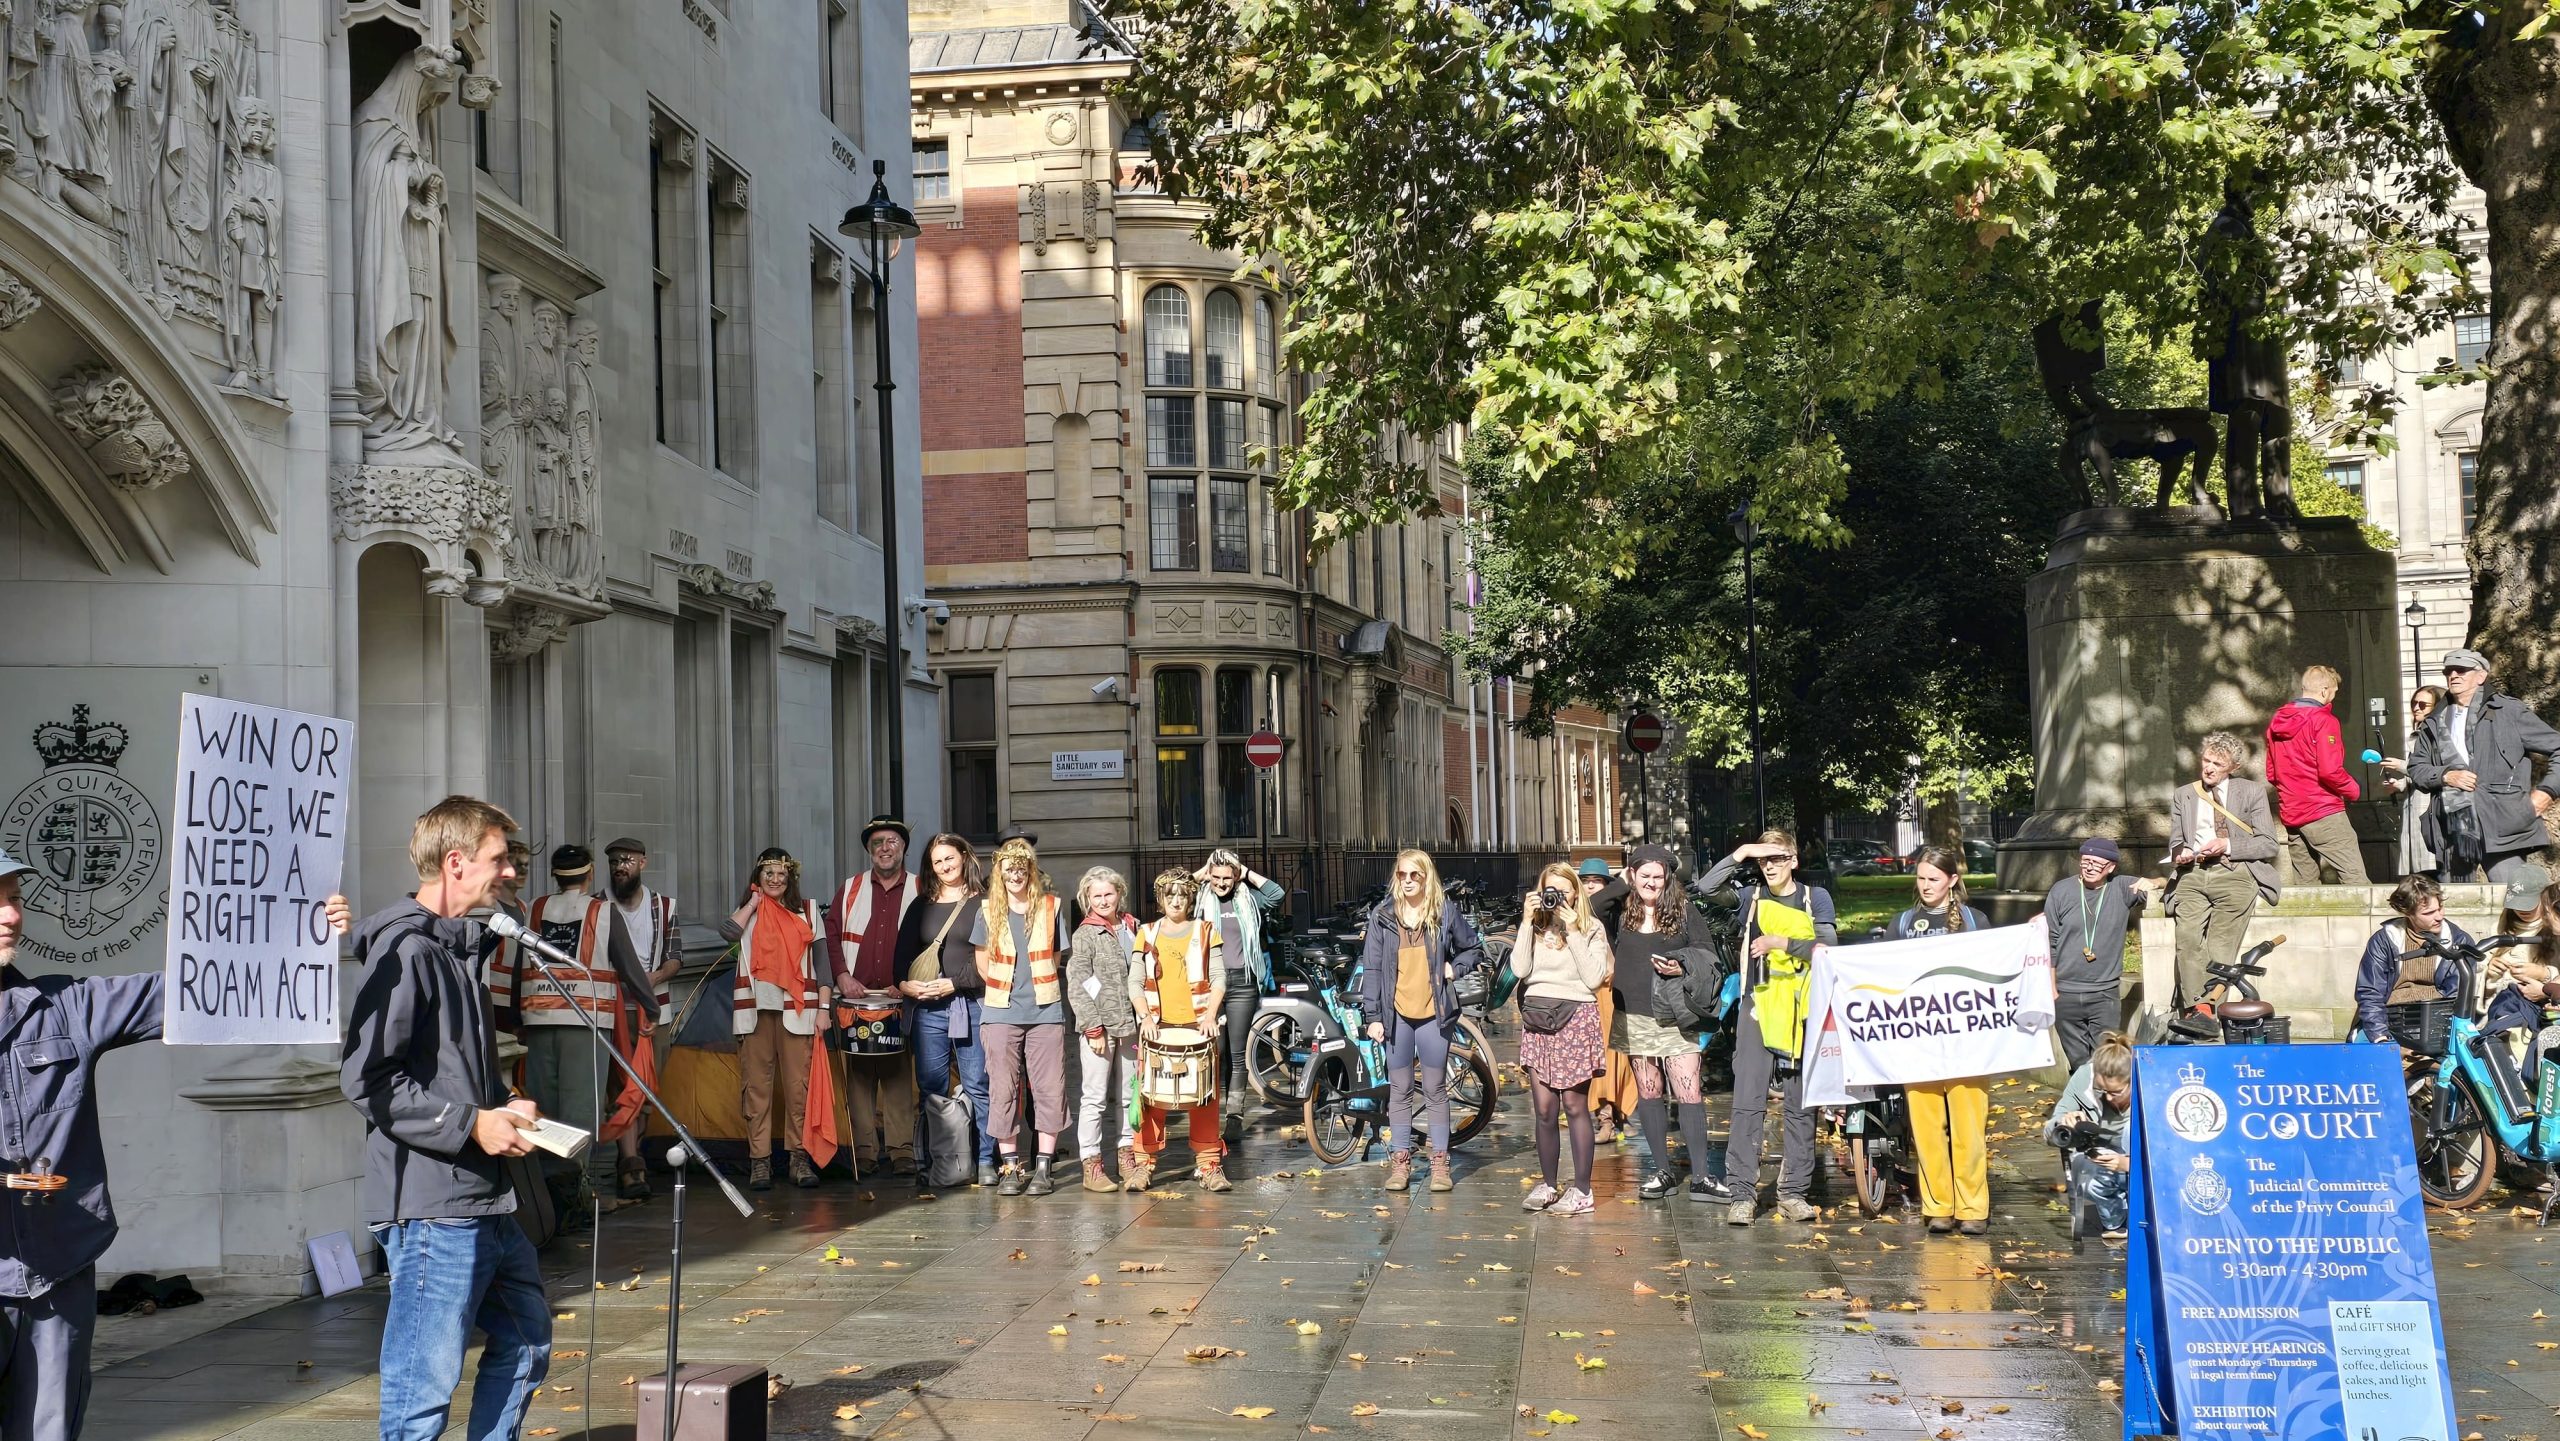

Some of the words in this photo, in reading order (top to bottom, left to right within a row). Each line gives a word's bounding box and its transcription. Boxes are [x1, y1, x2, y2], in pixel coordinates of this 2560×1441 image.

[194, 707, 278, 769] WIN
[291, 722, 338, 778] OR
[1056, 754, 1079, 762] LITTLE
[1056, 762, 1098, 771] SANCTUARY
[1101, 761, 1117, 769] SW1
[57, 775, 98, 792] QUI
[10, 785, 48, 827] SOIT
[104, 781, 141, 815] MAL
[187, 770, 274, 837] LOSE,
[288, 788, 335, 839] WE
[137, 817, 153, 828] Y
[116, 838, 155, 896] PENSE
[184, 836, 270, 890] NEED
[285, 843, 306, 896] A
[182, 890, 277, 945] RIGHT
[289, 897, 331, 947] TO
[18, 934, 77, 963] mittee
[81, 947, 99, 963] of
[103, 938, 132, 958] the
[129, 905, 168, 942] Privy
[179, 952, 264, 1019] ROAM
[275, 956, 333, 1025] ACT!
[1846, 987, 1996, 1023] CAMPAIGN
[2004, 990, 2019, 1008] fo
[1849, 1016, 1961, 1043] NATIONAL
[1967, 1009, 2019, 1033] PARK
[2233, 1063, 2266, 1079] The
[2237, 1083, 2381, 1107] SUPREME
[2542, 1066, 2556, 1115] forest
[2239, 1111, 2382, 1141] COURT
[2246, 1158, 2276, 1172] The
[2248, 1178, 2304, 1195] Judicial
[2306, 1179, 2389, 1193] Committee
[2252, 1200, 2269, 1214] of
[2270, 1201, 2293, 1214] the
[2297, 1200, 2333, 1217] Privy
[2336, 1199, 2395, 1214] Council
[2184, 1238, 2249, 1255] OPEN
[2249, 1237, 2274, 1255] TO
[2276, 1237, 2319, 1255] THE
[2324, 1237, 2401, 1254] PUBLIC
[2222, 1262, 2287, 1279] 9:30am
[2302, 1262, 2368, 1281] 4:30pm
[2181, 1307, 2216, 1319] FREE
[2218, 1306, 2300, 1319] ADMISSION
[2335, 1303, 2373, 1319] CAFÉ
[2337, 1322, 2357, 1332] and
[2359, 1322, 2384, 1332] GIFT
[2387, 1322, 2417, 1332] SHOP
[2186, 1342, 2250, 1354] OBSERVE
[2251, 1342, 2327, 1354] HEARINGS
[2341, 1346, 2382, 1358] Serving
[2383, 1347, 2411, 1358] great
[2188, 1358, 2217, 1369] (most
[2218, 1358, 2261, 1369] Mondays
[2267, 1358, 2318, 1369] Thursdays
[2342, 1359, 2379, 1371] coffee,
[2379, 1359, 2429, 1370] delicious
[2190, 1370, 2200, 1380] in
[2201, 1370, 2224, 1382] legal
[2226, 1371, 2249, 1380] term
[2250, 1370, 2277, 1381] time)
[2345, 1374, 2377, 1387] cakes,
[2379, 1374, 2399, 1385] and
[2401, 1374, 2427, 1388] light
[2347, 1389, 2392, 1400] lunches.
[2193, 1406, 2277, 1418] EXHIBITION
[2195, 1420, 2225, 1430] about
[2226, 1422, 2242, 1430] our
[2242, 1420, 2269, 1430] work
